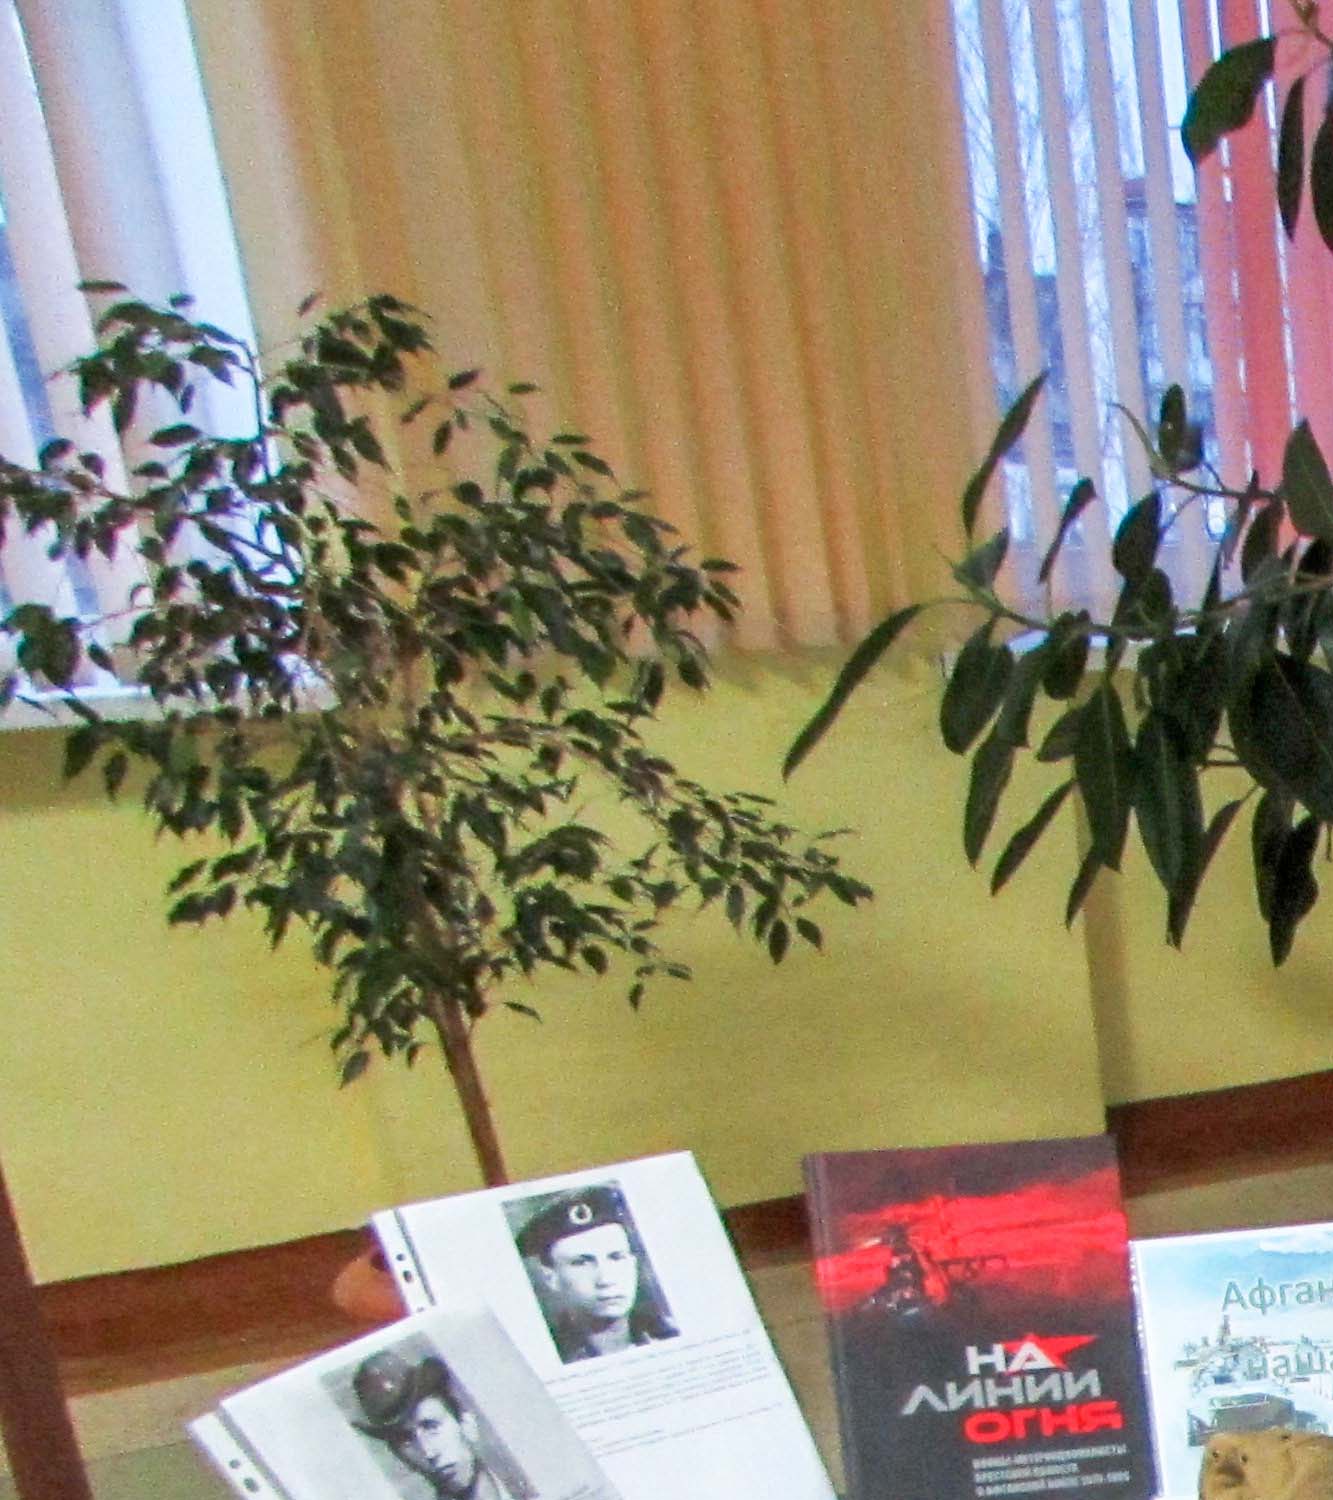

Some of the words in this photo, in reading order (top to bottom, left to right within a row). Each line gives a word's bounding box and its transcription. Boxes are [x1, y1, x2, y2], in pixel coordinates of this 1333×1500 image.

[965, 1341, 1057, 1375] НА
[901, 1368, 1102, 1416] ЛИНИИ
[963, 1400, 1124, 1445] ОГНЯ
